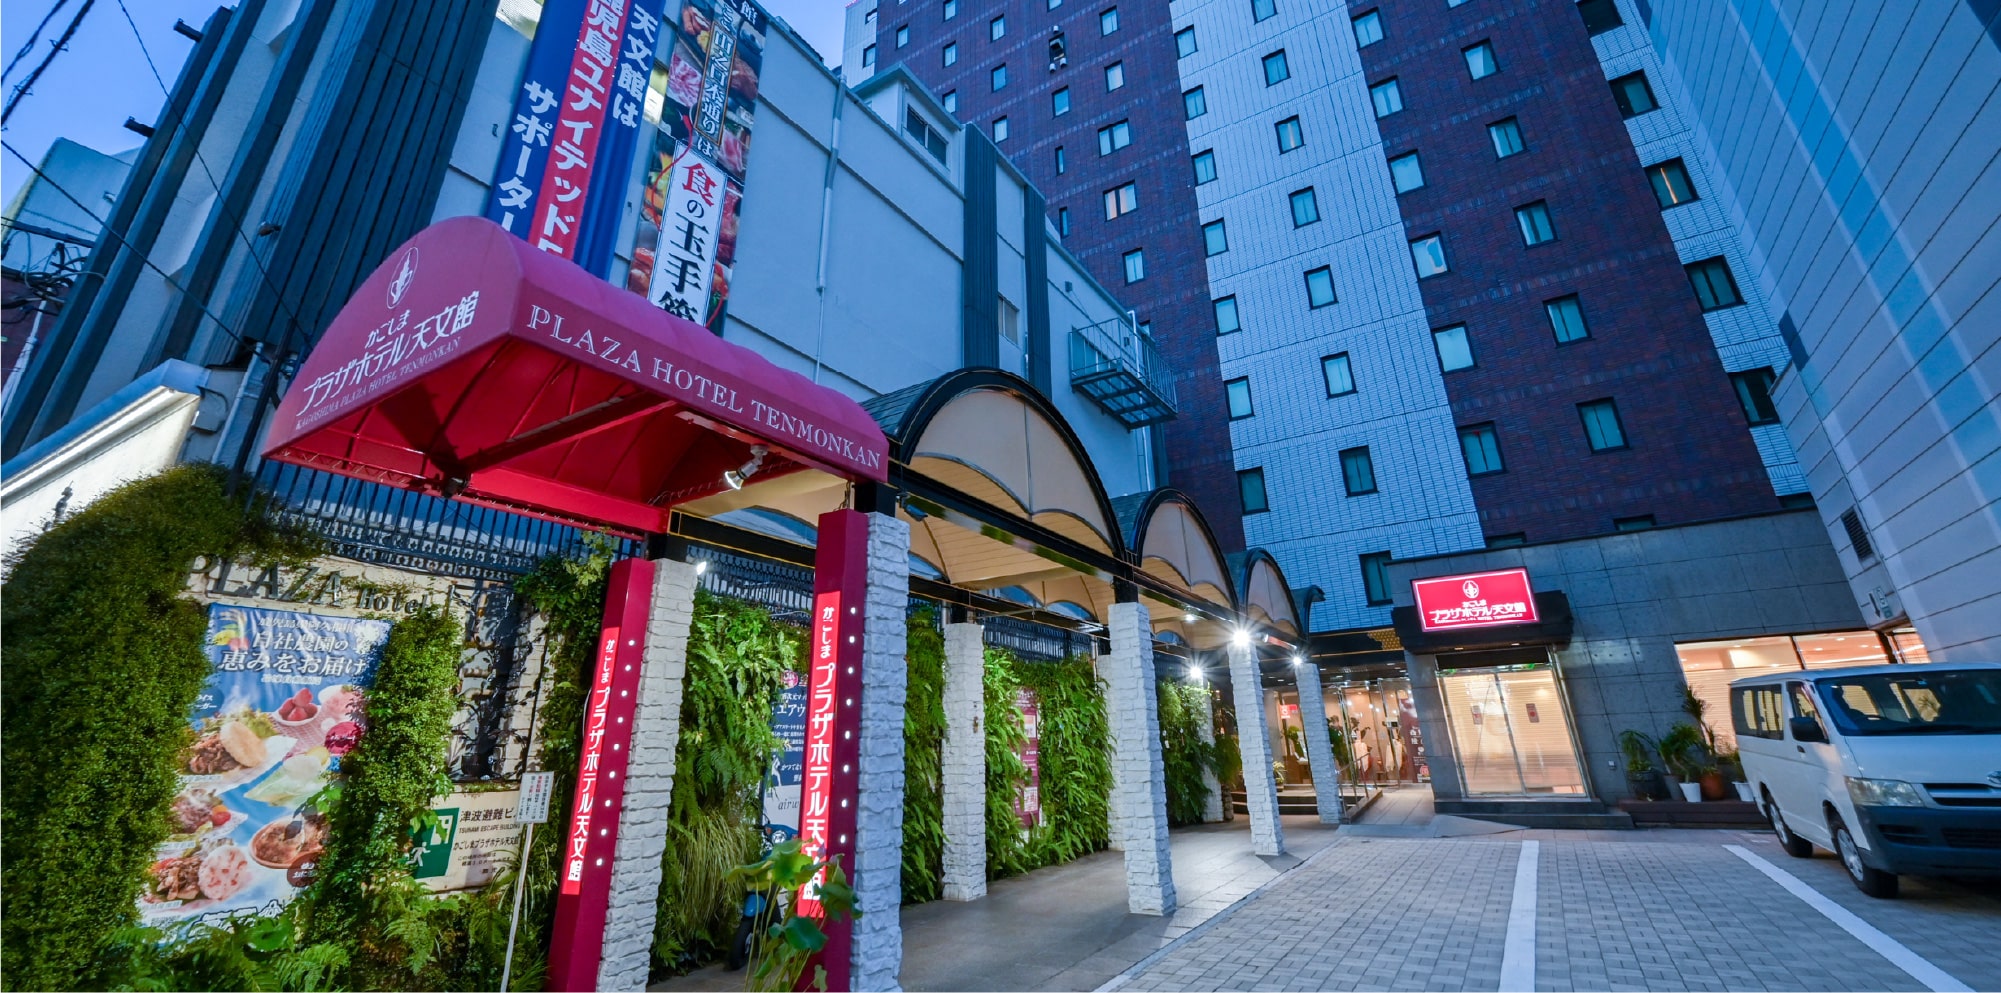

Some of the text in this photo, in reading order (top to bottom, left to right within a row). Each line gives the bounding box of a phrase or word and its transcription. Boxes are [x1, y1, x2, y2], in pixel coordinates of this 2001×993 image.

[612, 3, 658, 129] 天文館は
[498, 80, 558, 232] サポーター
[296, 290, 479, 416] プラザホテル天文館
[365, 309, 410, 349] かごしま
[295, 336, 461, 430] KAGOSHIMA PLAZA HOTEL TENMONKAN
[526, 304, 881, 470] PLAZA HOTEL TENMONKAN
[185, 553, 341, 607] PLAZA
[820, 605, 836, 659] かごしま
[1429, 602, 1527, 621] プラザホテル天文館
[218, 650, 367, 677] 恵みをお届け
[253, 631, 349, 653] 自社農園の
[567, 638, 616, 882] かごしま プラザホテル天文館
[460, 807, 516, 822] 津波避難ビ
